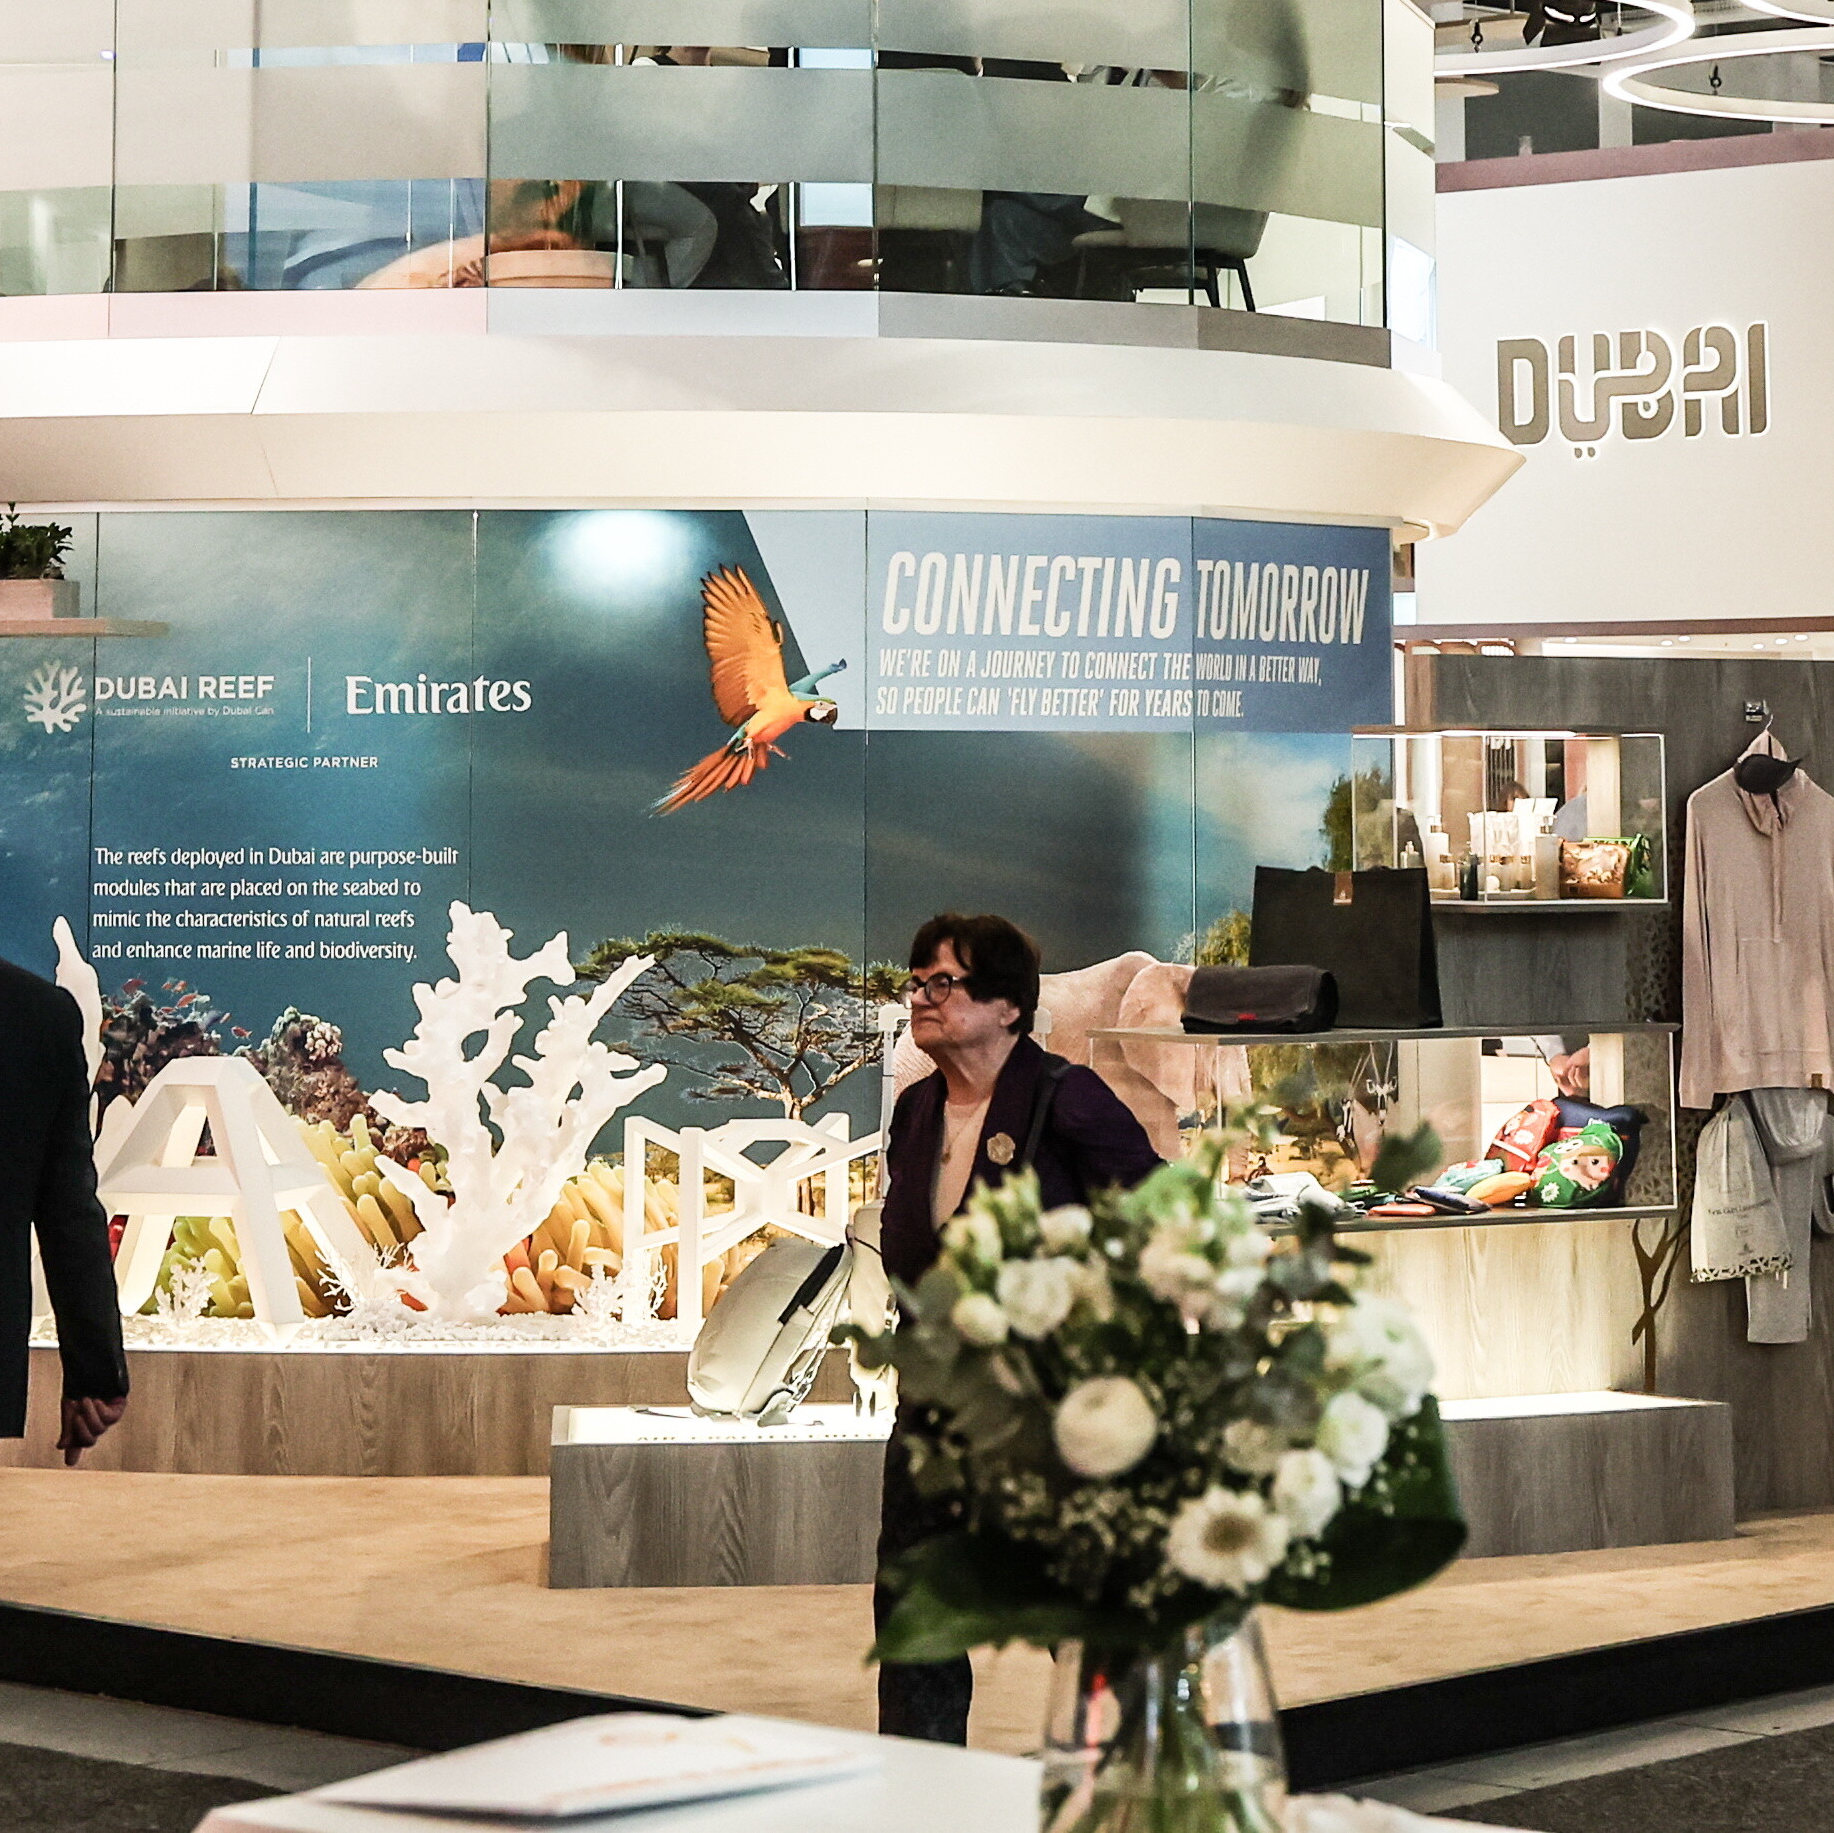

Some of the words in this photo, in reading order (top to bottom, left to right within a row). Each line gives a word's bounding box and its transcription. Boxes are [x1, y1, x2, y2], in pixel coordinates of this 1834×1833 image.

[1496, 322, 1769, 458] DUBAI
[880, 550, 1182, 640] CONNECTING
[1195, 558, 1371, 645] TOMORROW
[878, 648, 931, 678] WE'RE
[937, 650, 961, 678] ON
[965, 650, 977, 678] A
[980, 650, 1056, 679] JOURNEY
[1061, 651, 1081, 679] TO
[1084, 651, 1159, 681] CONNECT
[1162, 652, 1192, 681] THE
[1195, 653, 1232, 682] WORLD
[1234, 654, 1248, 682] IN
[1249, 654, 1257, 683] A
[1258, 655, 1296, 684] BETTER
[1297, 656, 1323, 687] WAY,
[94, 676, 188, 700] DUBAI
[198, 675, 275, 699] REEF
[345, 673, 533, 717] Emirates
[207, 706, 220, 718] by
[222, 705, 252, 716] Dubai
[875, 686, 897, 715] SO
[902, 686, 964, 715] PEOPLE
[966, 687, 1001, 715] CAN
[1008, 687, 1036, 716] 'FLY
[1040, 687, 1106, 716] BETTER'
[1108, 688, 1140, 717] FOR
[1143, 688, 1193, 718] YEARS
[1196, 690, 1210, 718] TO
[1211, 690, 1244, 719] COME.
[230, 756, 309, 769] STRATEGIC
[313, 756, 379, 768] PARTNER
[94, 848, 123, 865] The
[127, 848, 167, 865] reefs
[170, 848, 245, 868] deployed
[249, 848, 265, 865] in
[269, 848, 316, 865] Dubai
[320, 852, 346, 865] are
[350, 848, 460, 868] purpose-built
[93, 879, 161, 896] modules
[164, 879, 197, 896] that
[201, 883, 227, 896] are
[230, 879, 283, 900] placed
[287, 883, 309, 896] on
[312, 879, 339, 896] the
[343, 879, 399, 896] seabed
[403, 881, 423, 896] to
[92, 910, 142, 927] mimic
[145, 910, 172, 927] the
[176, 910, 289, 927] characteristics
[292, 910, 311, 927] of
[314, 910, 371, 927] natural
[375, 910, 416, 927] reefs
[92, 941, 122, 959] and
[126, 941, 193, 959] enhance
[196, 941, 253, 959] marine
[256, 941, 281, 959] life
[285, 941, 315, 959] and
[319, 941, 418, 963] biodiversity.
